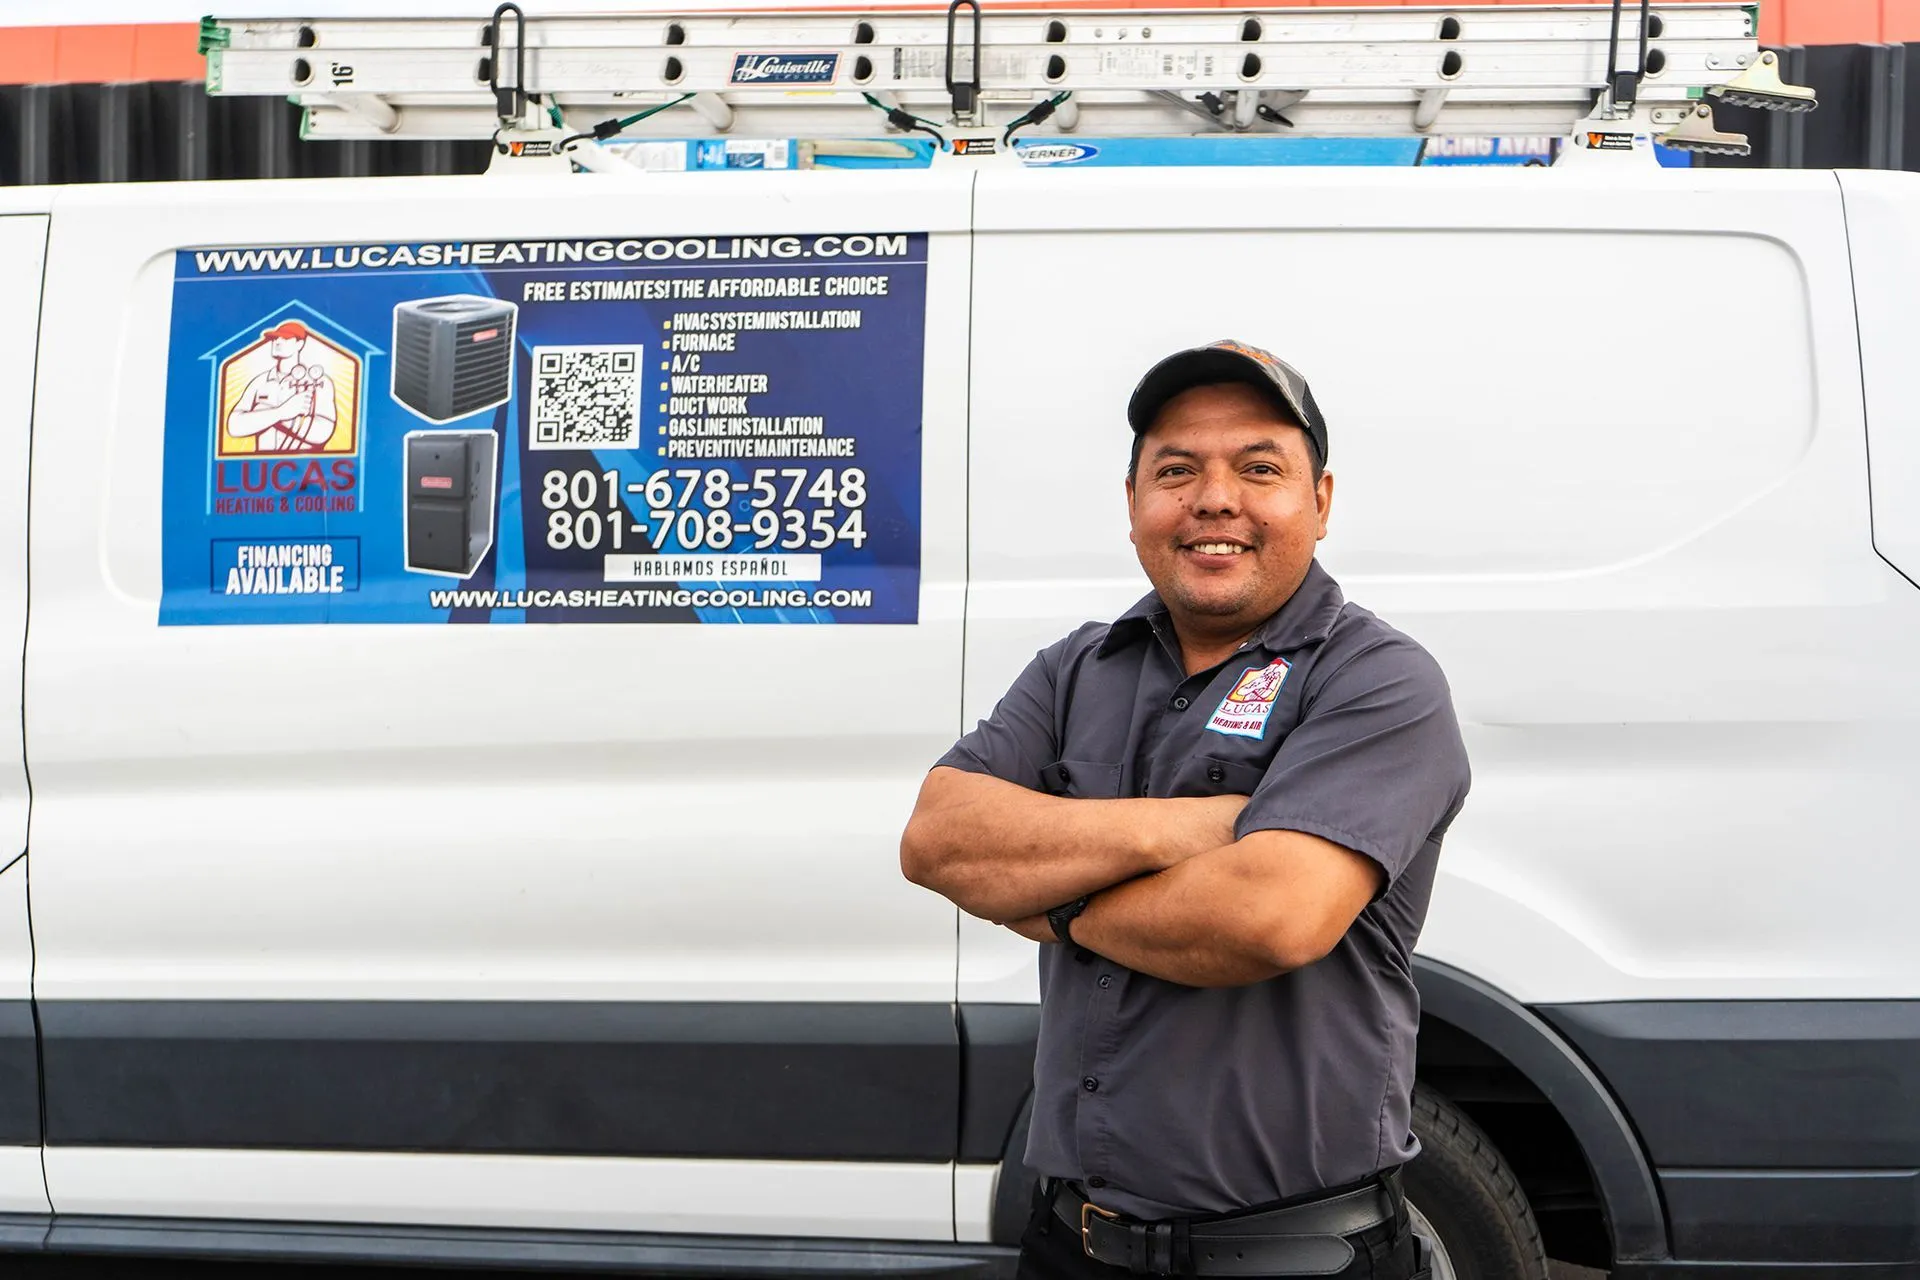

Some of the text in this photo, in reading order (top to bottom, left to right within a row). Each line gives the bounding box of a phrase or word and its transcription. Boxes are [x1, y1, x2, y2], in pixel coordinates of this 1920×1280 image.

[735, 55, 833, 81] Louisville
[196, 235, 908, 273] WWW.LUCASHEATINGCOOLING.COM
[523, 276, 889, 301] FREE ESTIMATES! THE AFFORDABLE CHOICE
[672, 333, 736, 352] FURNACE
[671, 354, 701, 373] A/C
[671, 374, 769, 394] WATER HEATER
[669, 396, 748, 415] DUCT WORK
[668, 418, 697, 437] GAS
[668, 438, 855, 458] PREVENTIVE MAINTENANCE
[217, 459, 357, 494] LUCAS
[541, 467, 868, 510] 801-678-5748
[216, 495, 356, 515] HEATING & COOLING
[546, 509, 868, 551] 801-708-9354
[237, 543, 333, 569] FINANCING
[633, 556, 789, 577] HABLAMOS ESPAÑOL
[225, 565, 345, 596] AVAILABLE
[430, 589, 872, 608] WWW.LUCASHEATINGCOOLING.COM
[1221, 702, 1271, 714] LUCAS
[1212, 716, 1241, 730] HEATING
[1249, 721, 1263, 731] AIR
